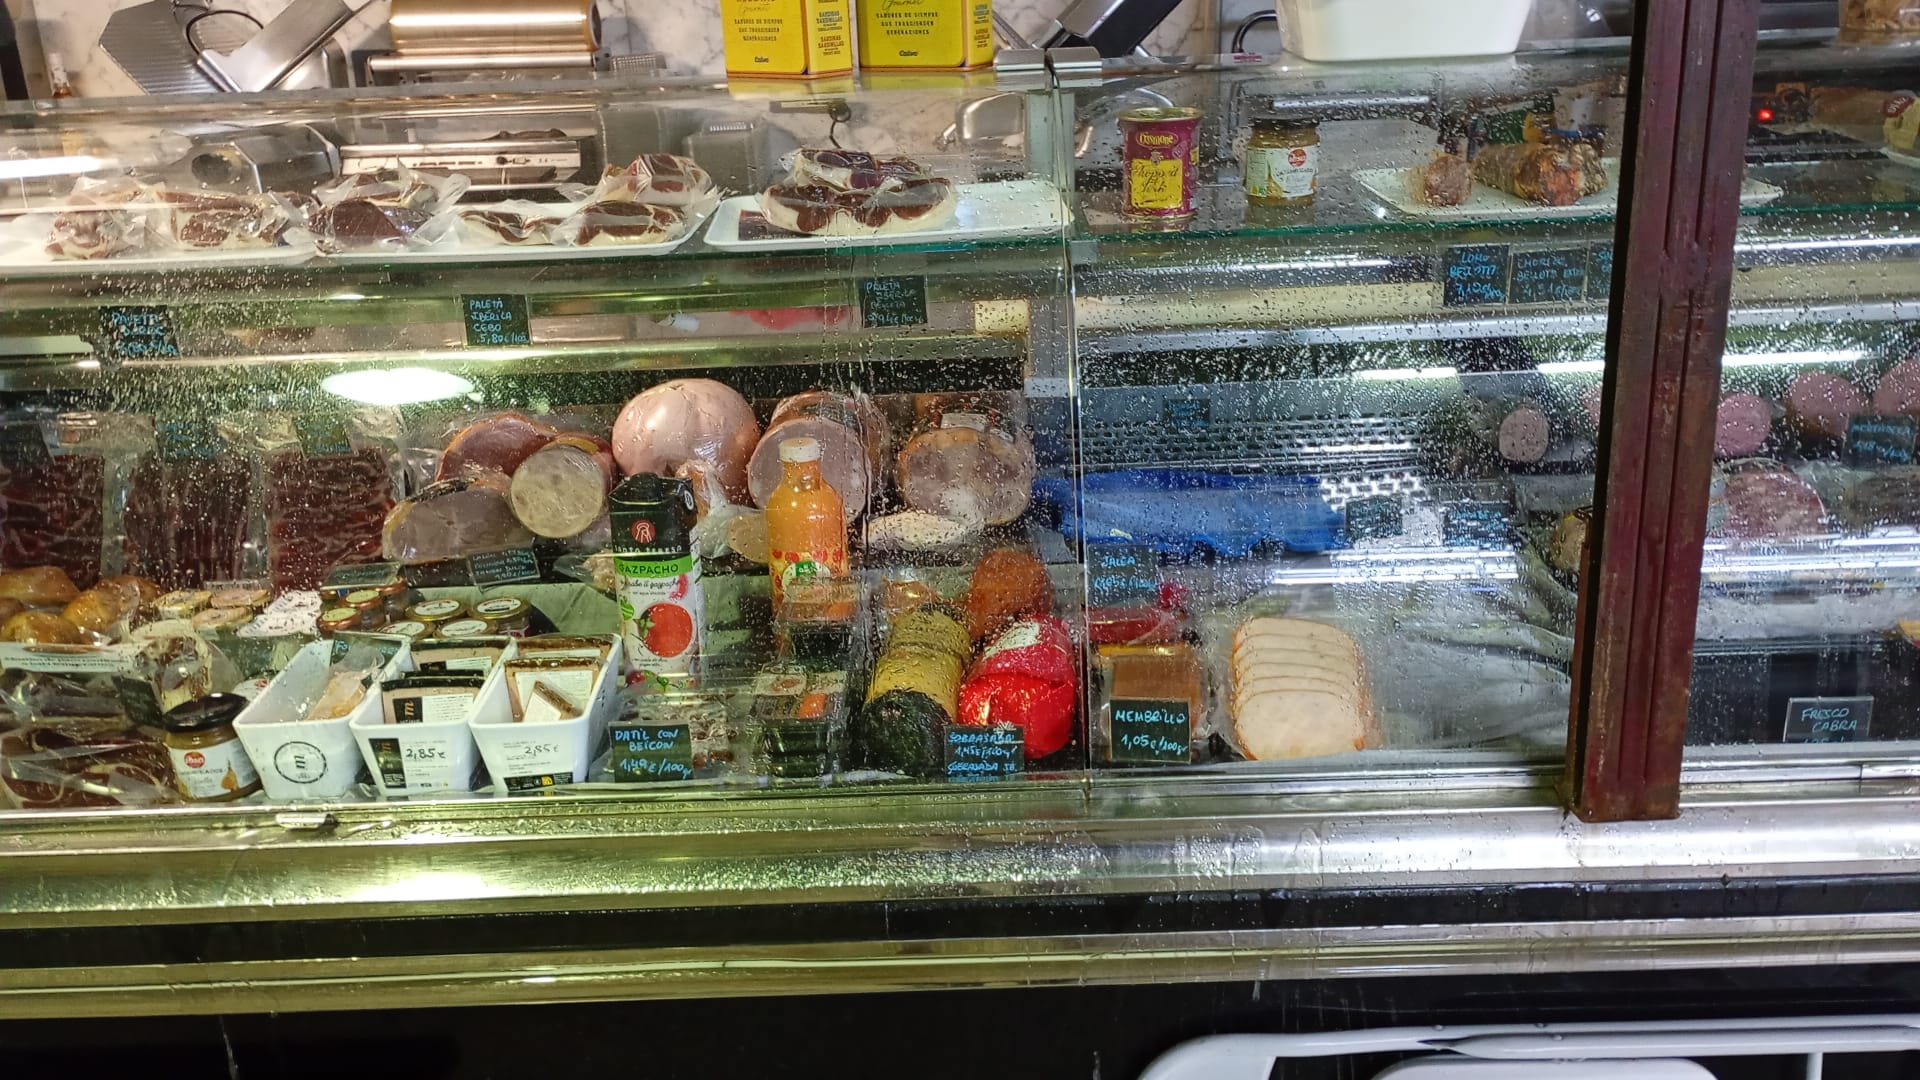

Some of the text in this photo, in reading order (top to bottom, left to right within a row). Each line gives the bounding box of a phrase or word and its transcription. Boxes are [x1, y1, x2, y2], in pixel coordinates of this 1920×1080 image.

[469, 298, 503, 311] PALETA
[473, 323, 502, 332] CEBO
[1100, 555, 1136, 568] JALEA
[618, 563, 679, 575] GAZPACHO
[1115, 708, 1187, 724] MEMBRILLO
[1801, 707, 1850, 722] FRESCO
[1812, 719, 1858, 733] CABRA
[657, 728, 679, 739] CON
